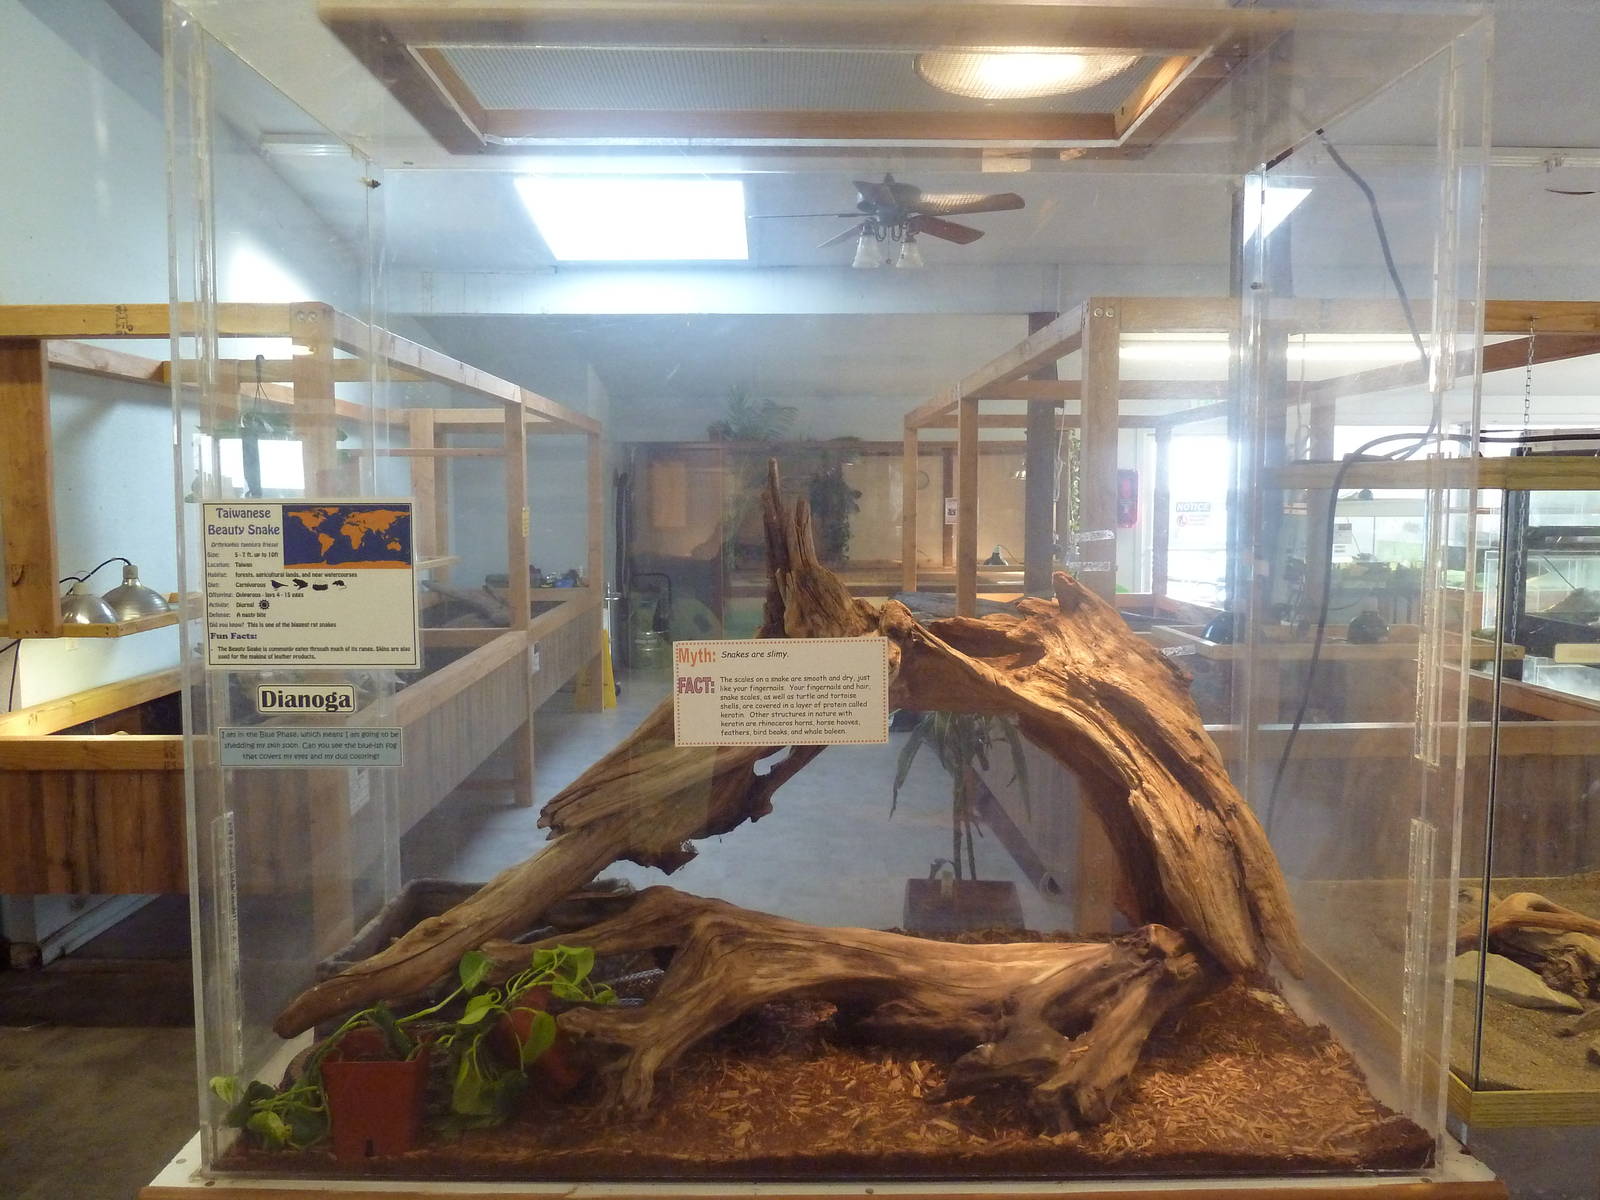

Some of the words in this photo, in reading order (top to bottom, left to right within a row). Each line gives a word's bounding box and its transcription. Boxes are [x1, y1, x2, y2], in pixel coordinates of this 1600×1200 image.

[1176, 502, 1210, 512] NOTICE
[216, 508, 272, 518] Taiwanese
[208, 524, 244, 535] Beauty
[248, 524, 280, 535] Snake
[678, 648, 716, 666] Myth:
[720, 650, 749, 659] Snakes
[767, 650, 790, 660] slimy.
[678, 676, 715, 694] FACT:
[842, 674, 856, 682] dry,
[857, 674, 870, 682] just
[806, 684, 841, 692] fingernails
[262, 690, 352, 712] Dianoga
[796, 702, 814, 710] layer
[822, 701, 847, 709] protein
[720, 730, 752, 738] feathers,
[768, 728, 790, 736] beaks,
